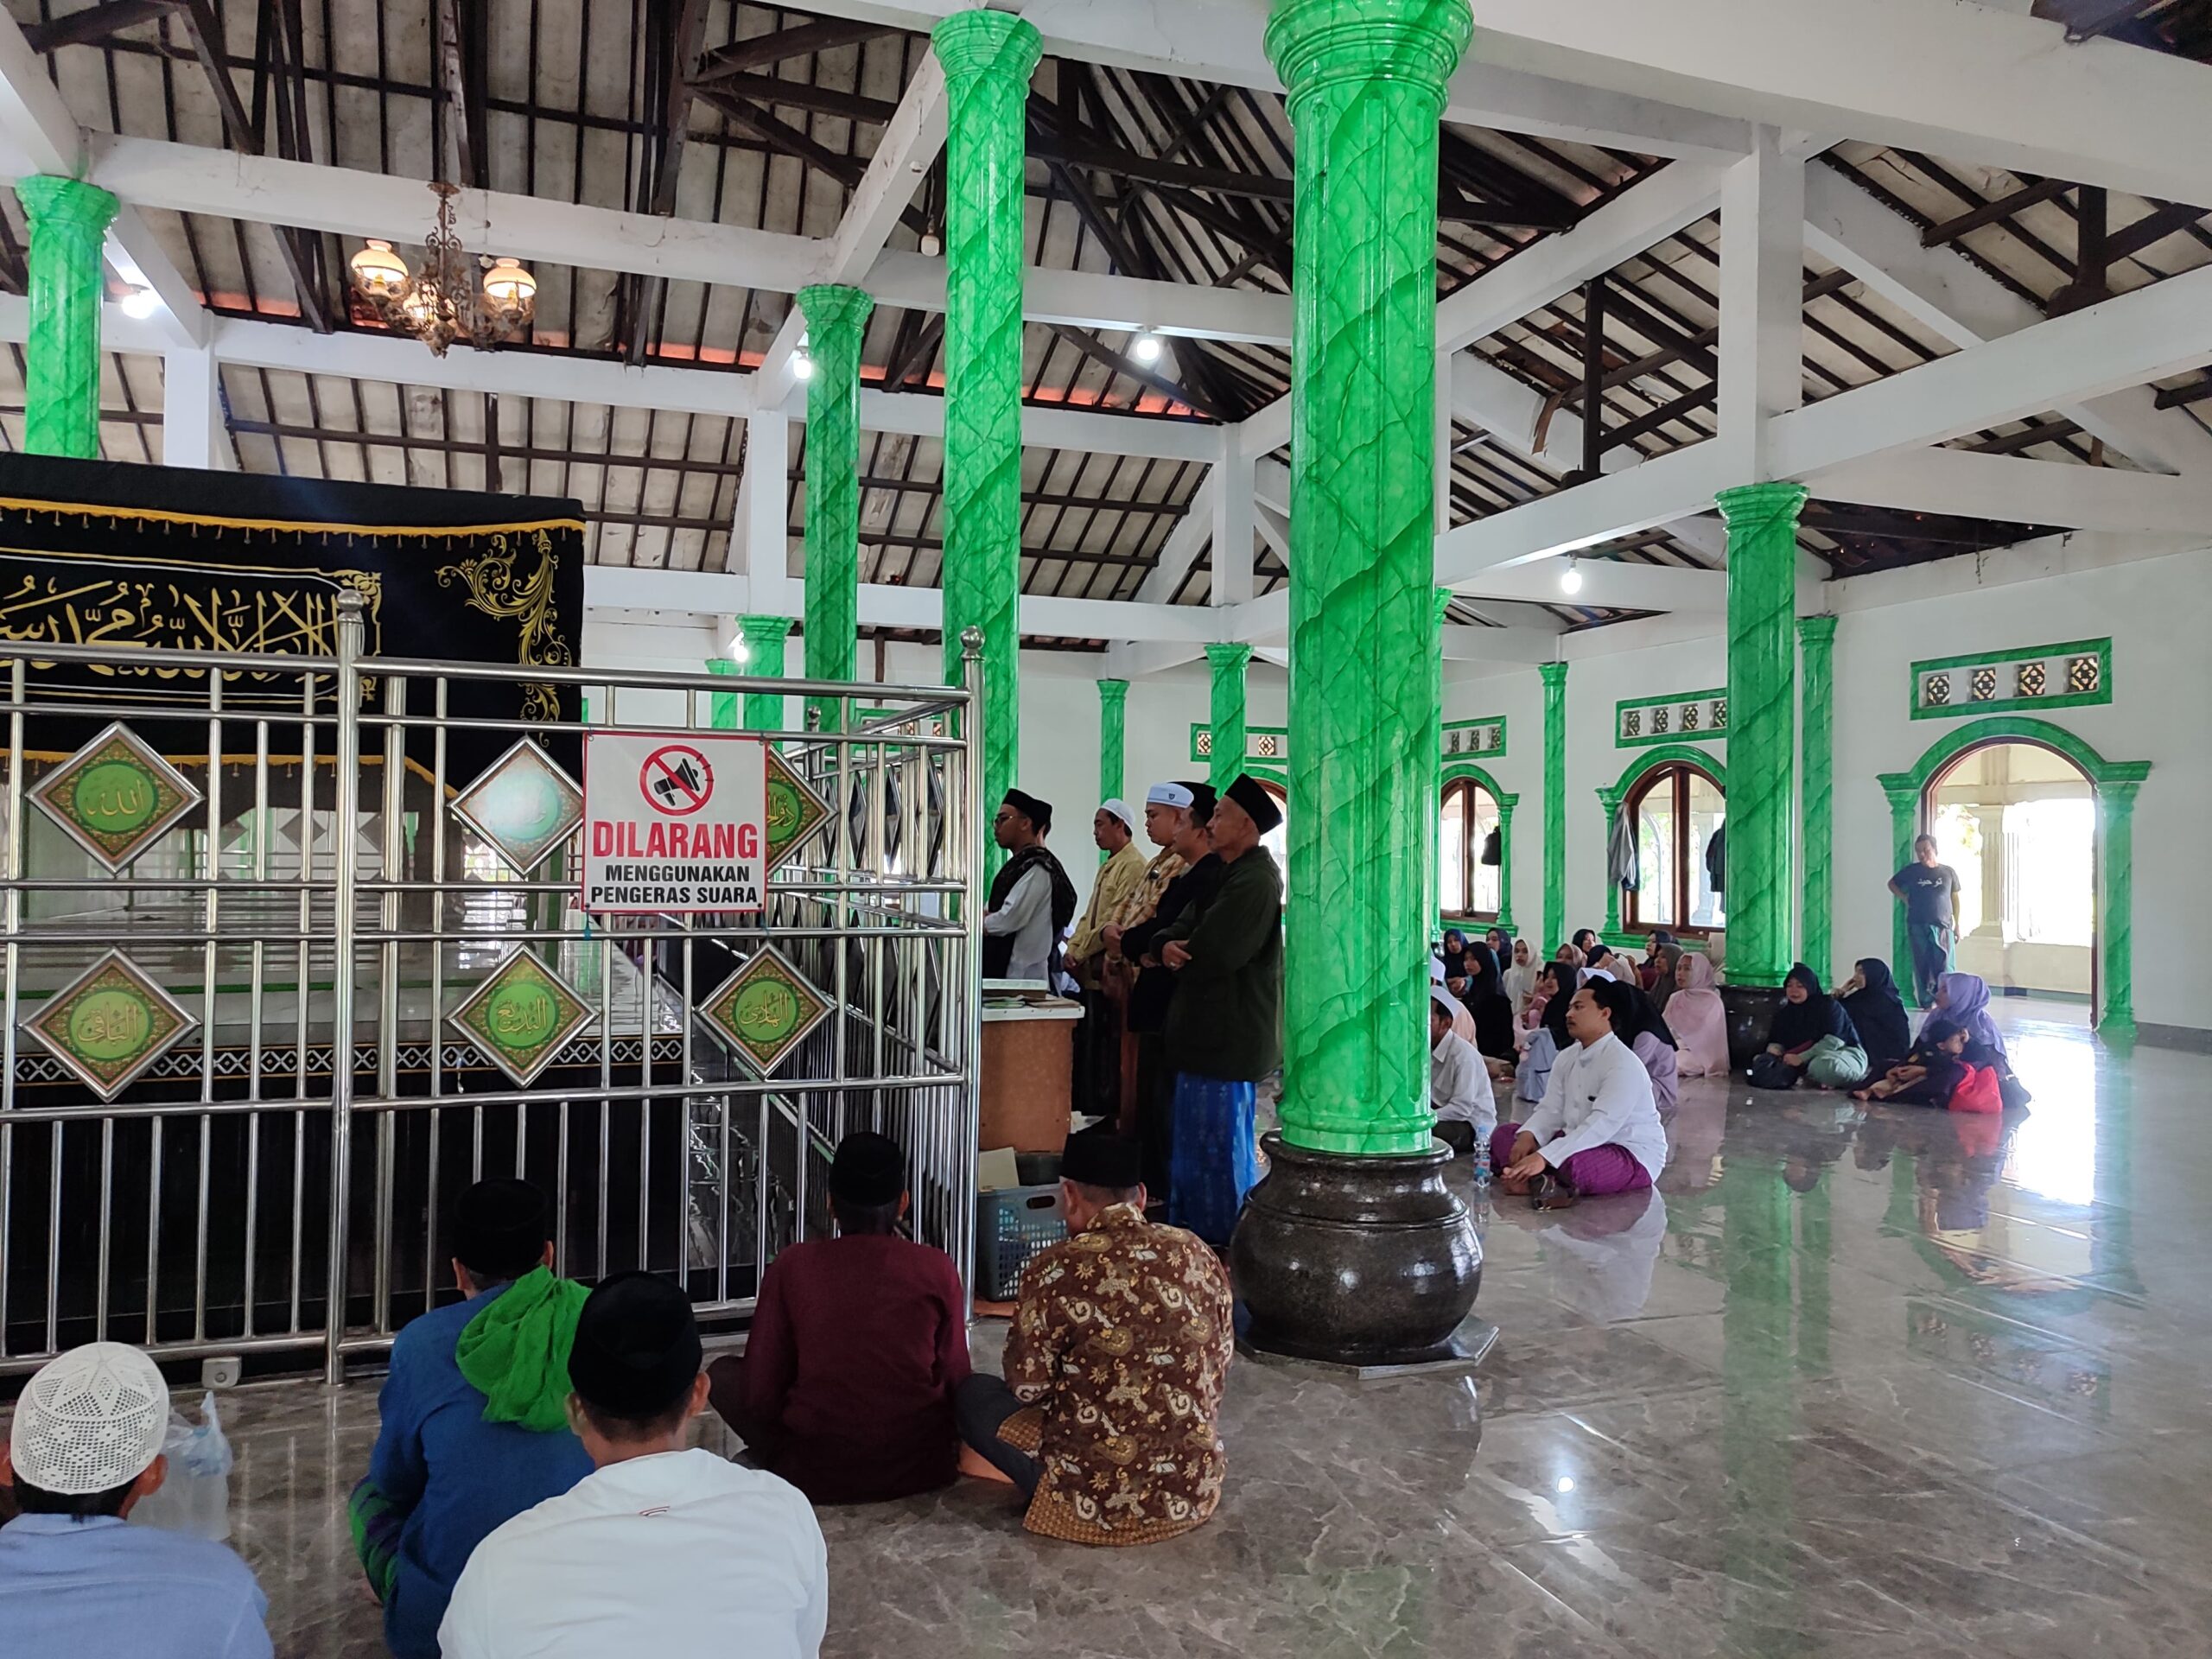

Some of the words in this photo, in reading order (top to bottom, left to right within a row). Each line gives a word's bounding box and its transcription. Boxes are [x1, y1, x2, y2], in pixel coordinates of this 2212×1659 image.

[592, 820, 758, 859] DILARANG
[605, 864, 750, 882] MENGGUNAKAN
[591, 886, 690, 904] PENGERAS
[696, 887, 758, 904] SUARA
